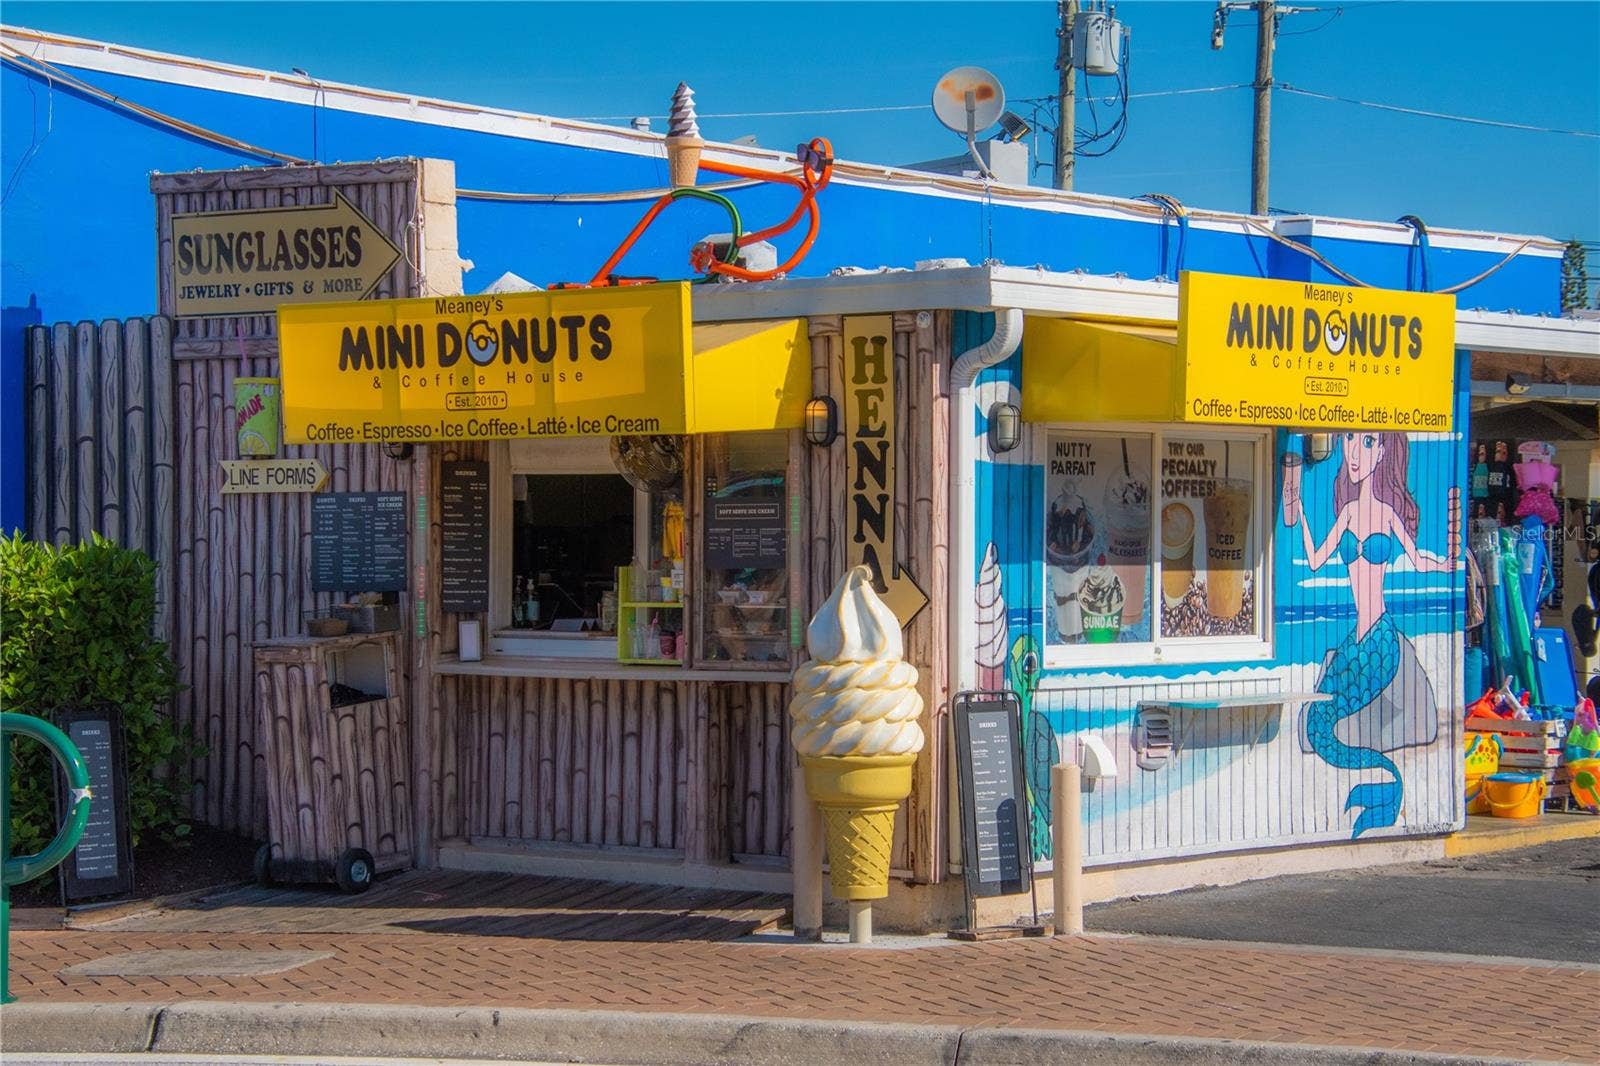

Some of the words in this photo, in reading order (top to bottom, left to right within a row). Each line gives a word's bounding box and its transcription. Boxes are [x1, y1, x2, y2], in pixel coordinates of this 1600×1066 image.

[178, 226, 362, 276] SUNGLASSES
[179, 283, 241, 299] JEWELRY
[254, 281, 294, 297] GIFTS
[303, 281, 314, 294] &
[323, 278, 363, 294] MORE
[435, 296, 503, 316] Meaney's
[1226, 302, 1294, 351] MINI
[1303, 307, 1423, 361] DONUTS
[338, 323, 425, 371] MINI
[436, 314, 612, 368] DONUTS
[1250, 354, 1258, 367] &
[1272, 355, 1335, 371] Coffee
[1349, 360, 1401, 375] House
[372, 376, 382, 389] &
[402, 373, 485, 388] Coffee
[507, 371, 583, 384] House
[454, 396, 471, 407] Est.
[475, 395, 499, 406] 2010
[1193, 398, 1232, 417] Coffee
[1240, 400, 1293, 422] Espresso
[1299, 403, 1316, 421] Ice
[1319, 404, 1354, 423] Coffee
[1361, 406, 1388, 424] Latté
[1394, 407, 1410, 425] Ice
[1413, 409, 1447, 426] Cream
[306, 423, 354, 440] Coffee
[363, 422, 432, 442] Espresso
[441, 420, 463, 437] Ice
[467, 418, 518, 436] Coffee
[528, 416, 567, 434] Latté
[577, 416, 601, 433] Ice
[605, 415, 660, 433] Cream
[1056, 442, 1092, 457] NUTTY
[1168, 442, 1184, 456] TRY
[1186, 443, 1205, 457] OUR
[230, 468, 260, 486] LINE
[266, 467, 316, 485] FORMS
[1051, 460, 1096, 476] PARFAIT
[1161, 459, 1217, 477] PECIALTY
[1216, 534, 1235, 545] ICED
[1208, 548, 1242, 560] COFFEE
[1083, 615, 1120, 629] SUNDAE
